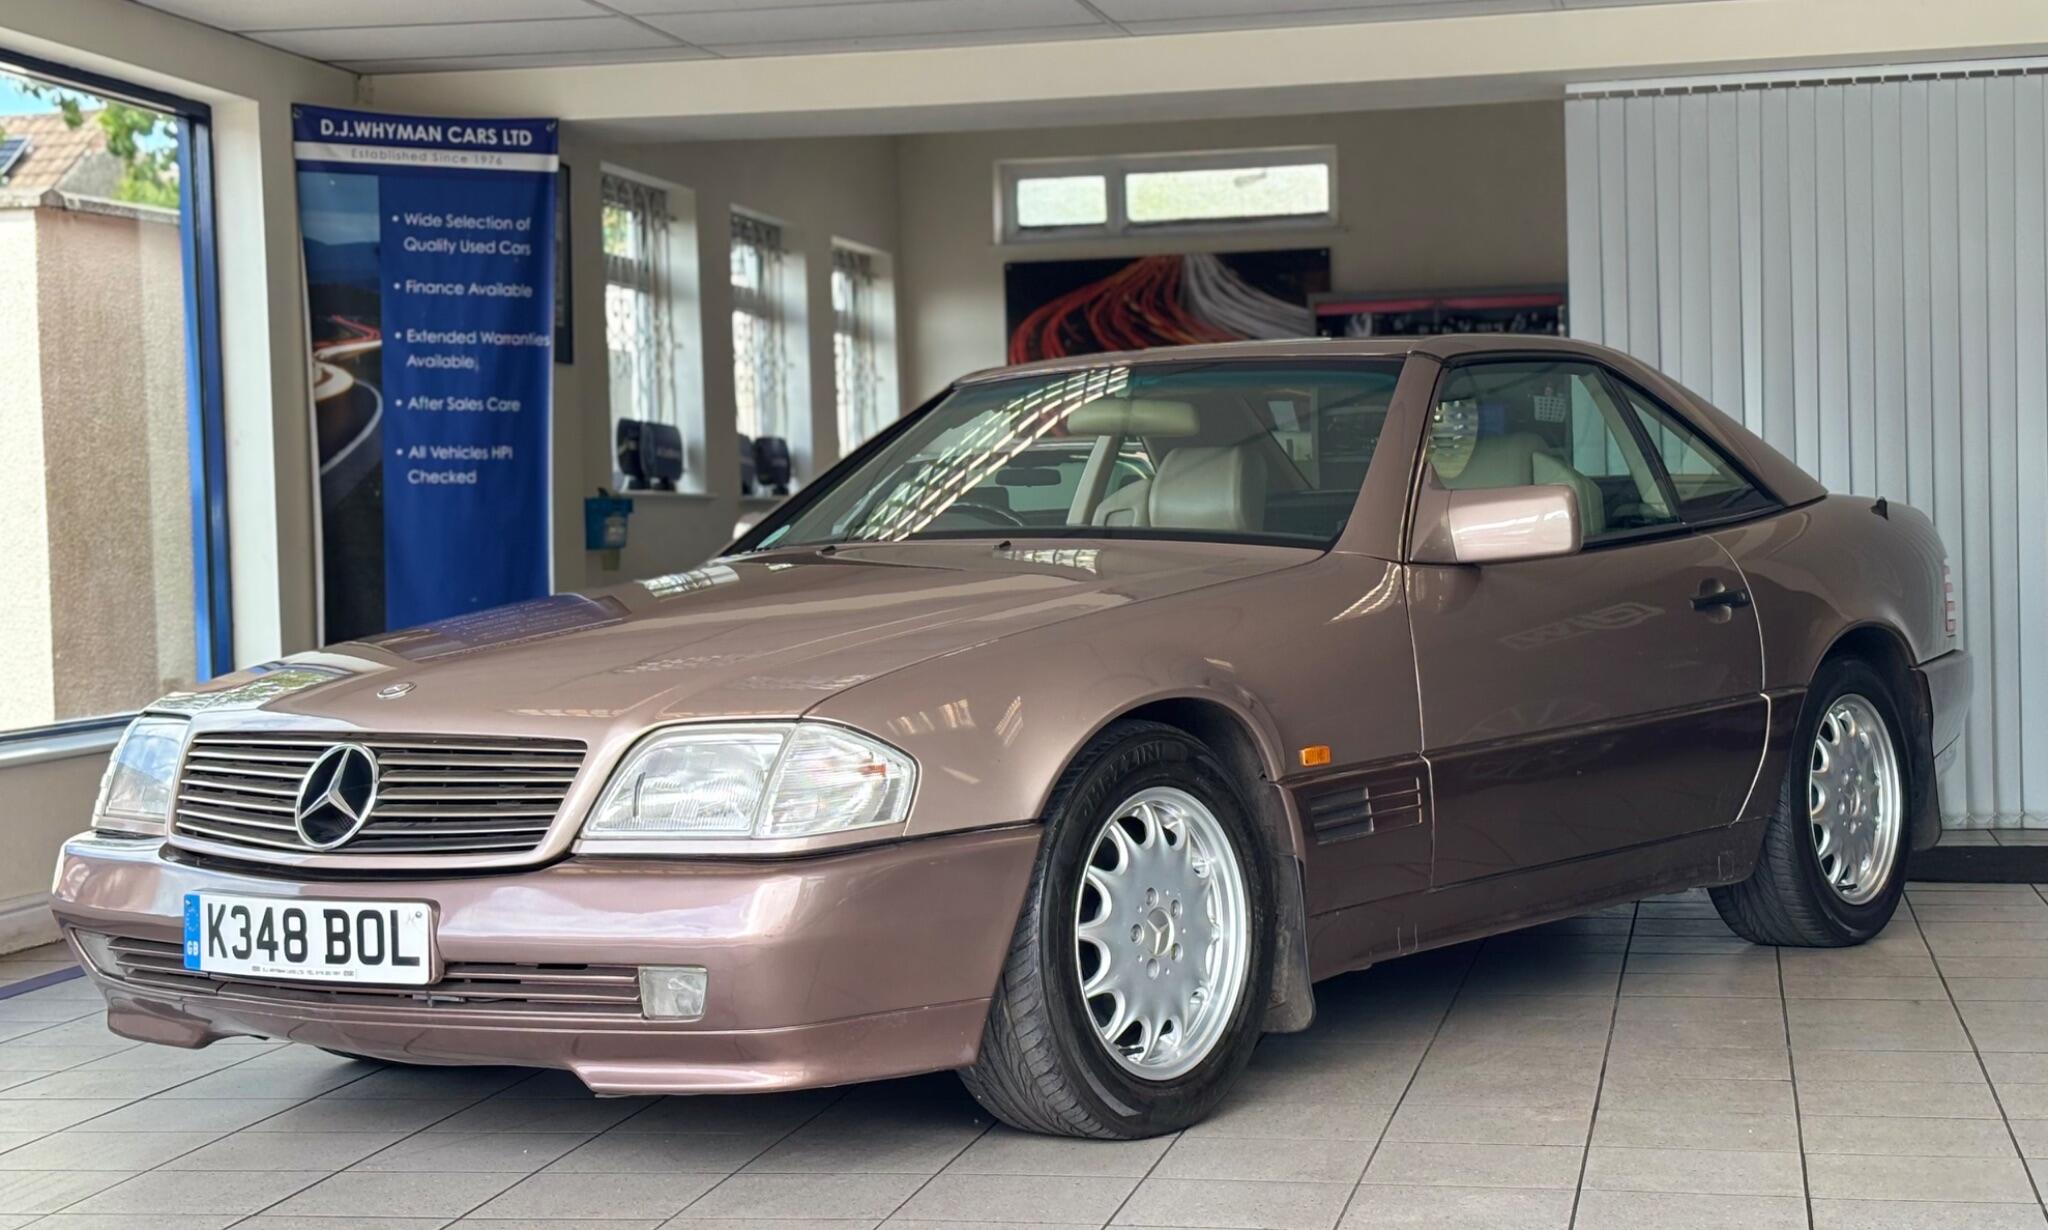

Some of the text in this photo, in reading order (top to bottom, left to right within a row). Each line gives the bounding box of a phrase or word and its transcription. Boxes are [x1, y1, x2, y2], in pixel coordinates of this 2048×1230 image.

[320, 118, 533, 146] D.J.WHYMAN CARS LTD
[351, 148, 504, 166] Established Since 1976
[404, 212, 532, 231] Wide Selection of
[403, 236, 531, 256] Quality Used Cars
[405, 279, 533, 298] Finance Available
[406, 329, 550, 347] Extended Warranties
[408, 395, 521, 413] After Sales Care
[408, 445, 514, 461] All Vehicles HPI
[407, 469, 478, 485] Checked
[207, 903, 421, 968] K348 BOL
[187, 940, 199, 957] GB
